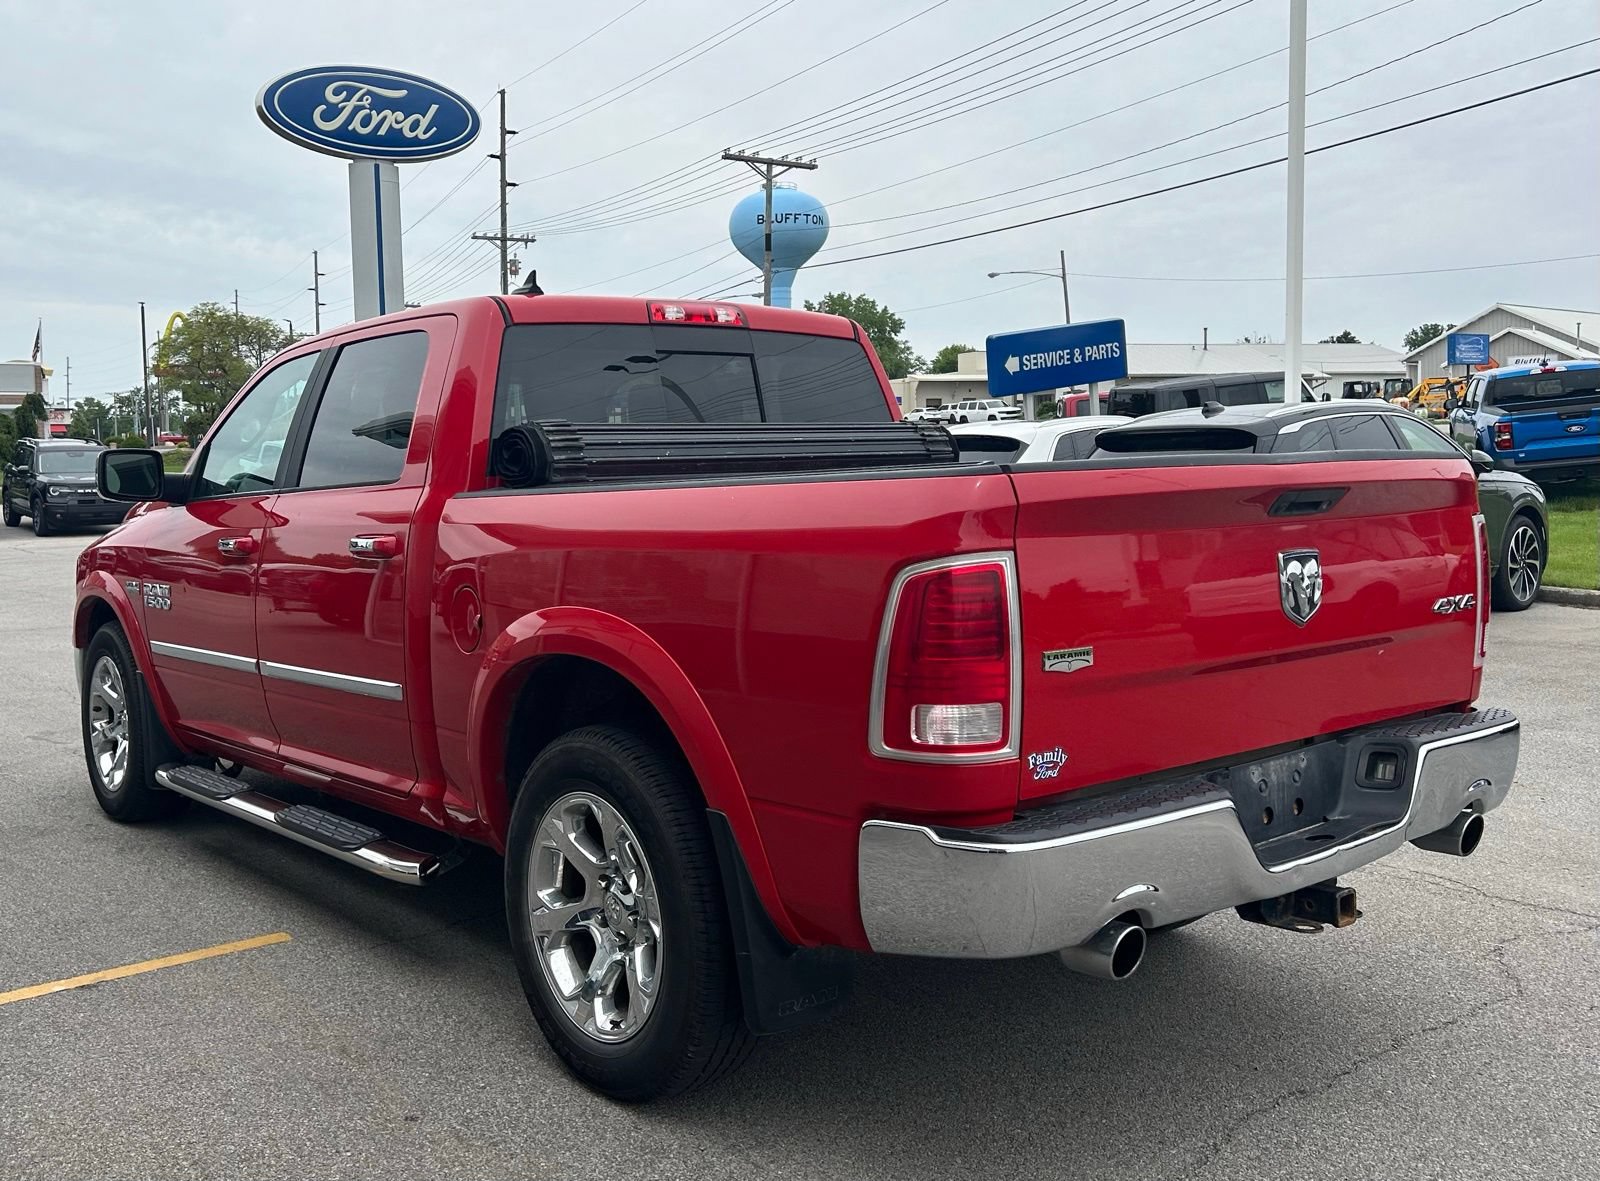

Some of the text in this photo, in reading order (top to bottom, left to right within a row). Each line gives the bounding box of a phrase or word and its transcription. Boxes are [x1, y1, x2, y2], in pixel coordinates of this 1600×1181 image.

[312, 80, 440, 140] Ford
[1022, 342, 1120, 371] SERVICE & PARTS
[143, 595, 171, 610] 1500
[1046, 650, 1092, 661] LARAMIE
[1028, 747, 1069, 770] Family
[1033, 763, 1060, 780] Ford
